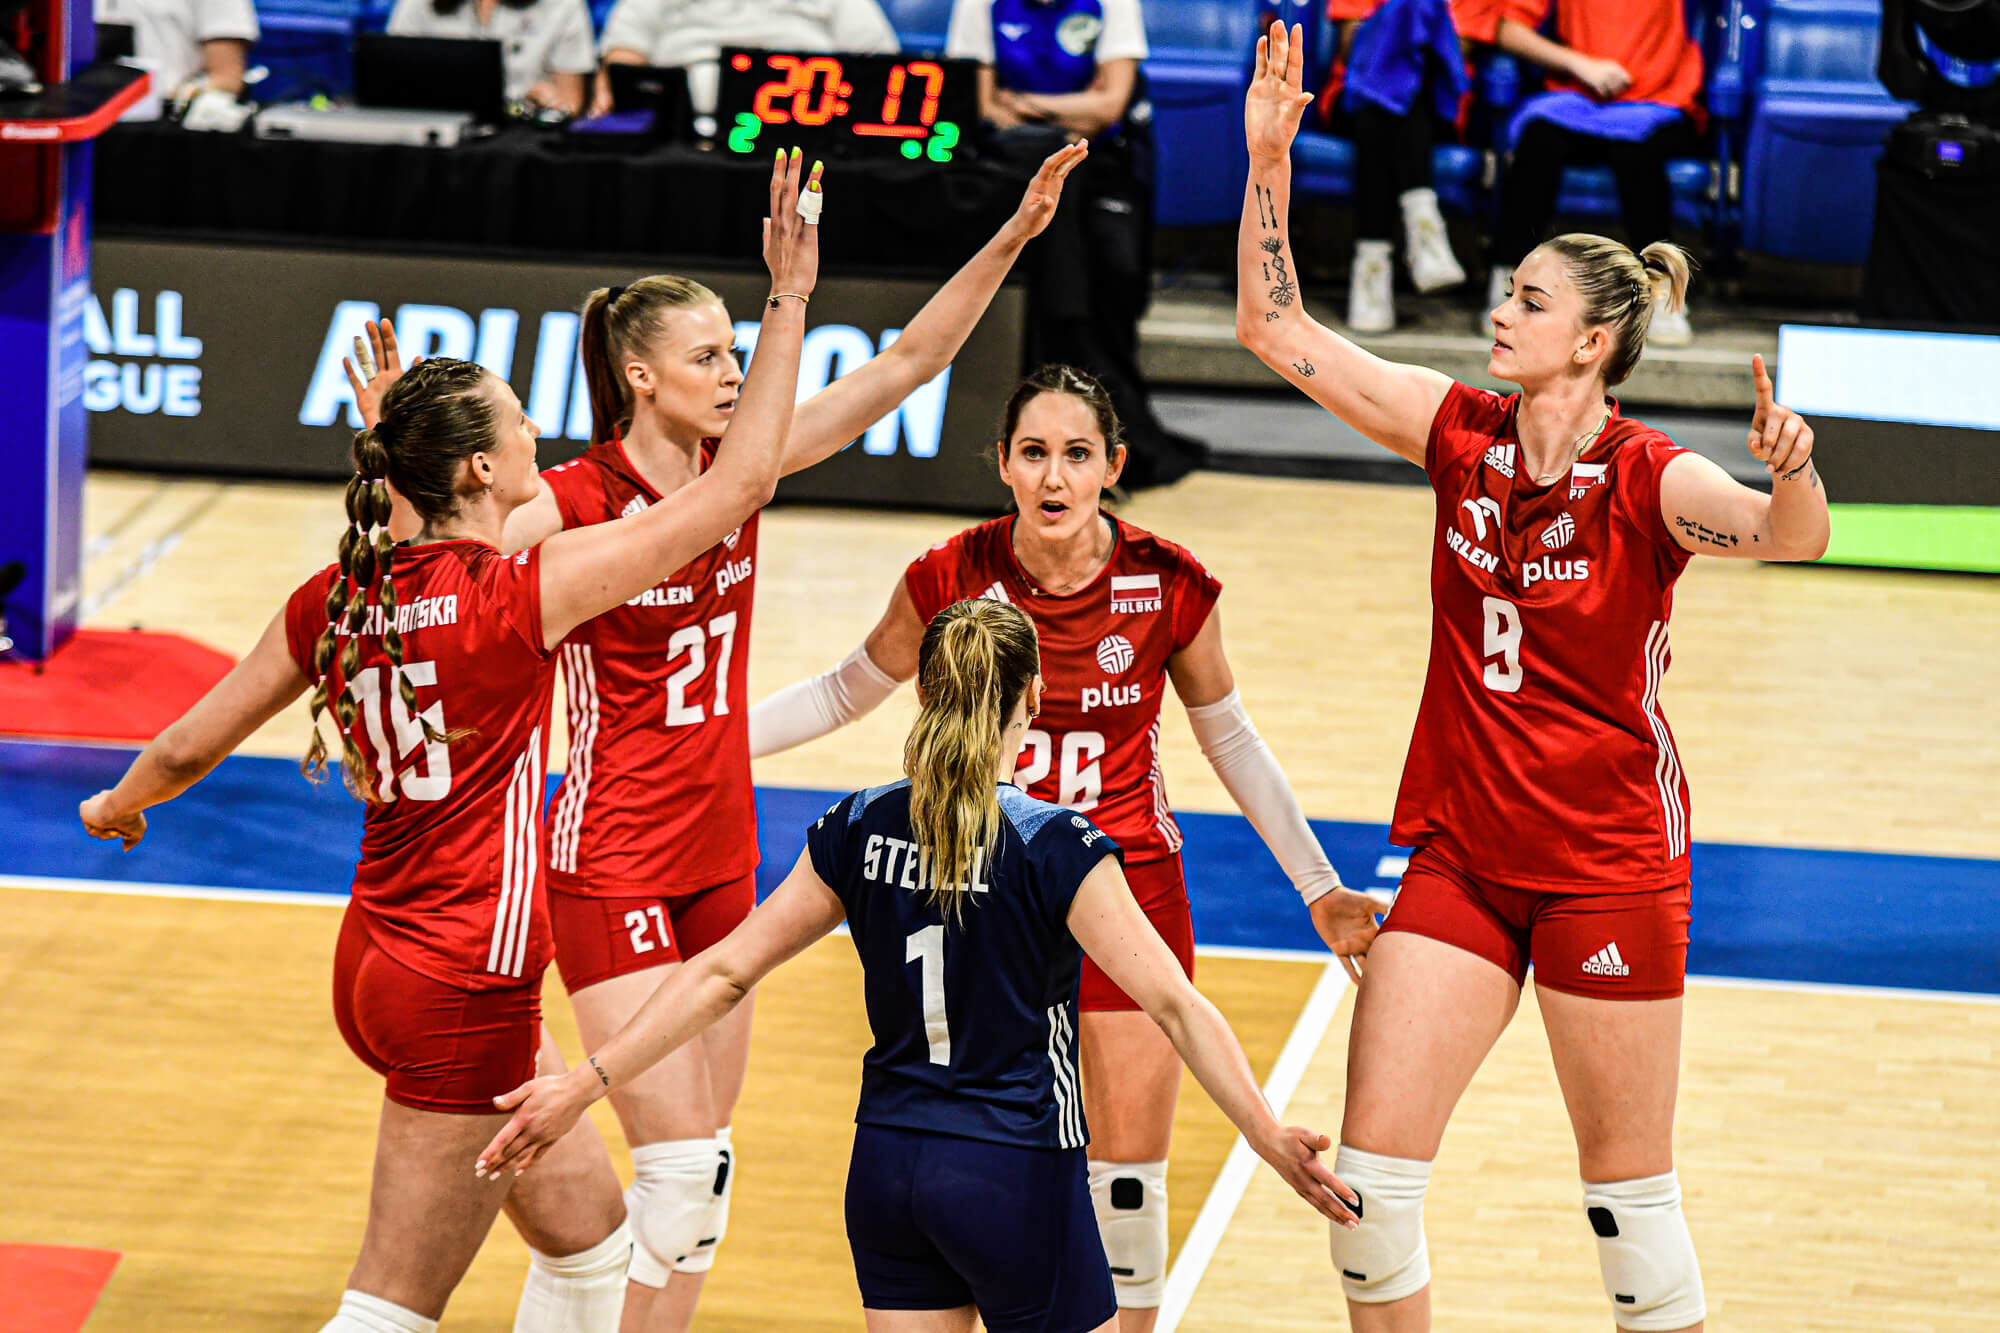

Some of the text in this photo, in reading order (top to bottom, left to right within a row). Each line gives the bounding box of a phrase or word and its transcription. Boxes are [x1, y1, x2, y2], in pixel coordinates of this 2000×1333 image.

[881, 61, 945, 126] 17
[728, 112, 960, 162] 2 2
[1483, 450, 1516, 479] adidas
[1446, 526, 1500, 574] ORLEN
[1522, 555, 1590, 588] plus
[716, 556, 753, 596] plus
[1110, 600, 1162, 614] POLSKA
[664, 610, 738, 727] 27
[1482, 595, 1524, 693] 9
[1081, 681, 1142, 713] plus
[350, 660, 453, 803] 15
[1013, 729, 1106, 813] 26
[624, 905, 671, 954] 27
[1582, 960, 1630, 976] adidas
[906, 924, 951, 1067] 1
